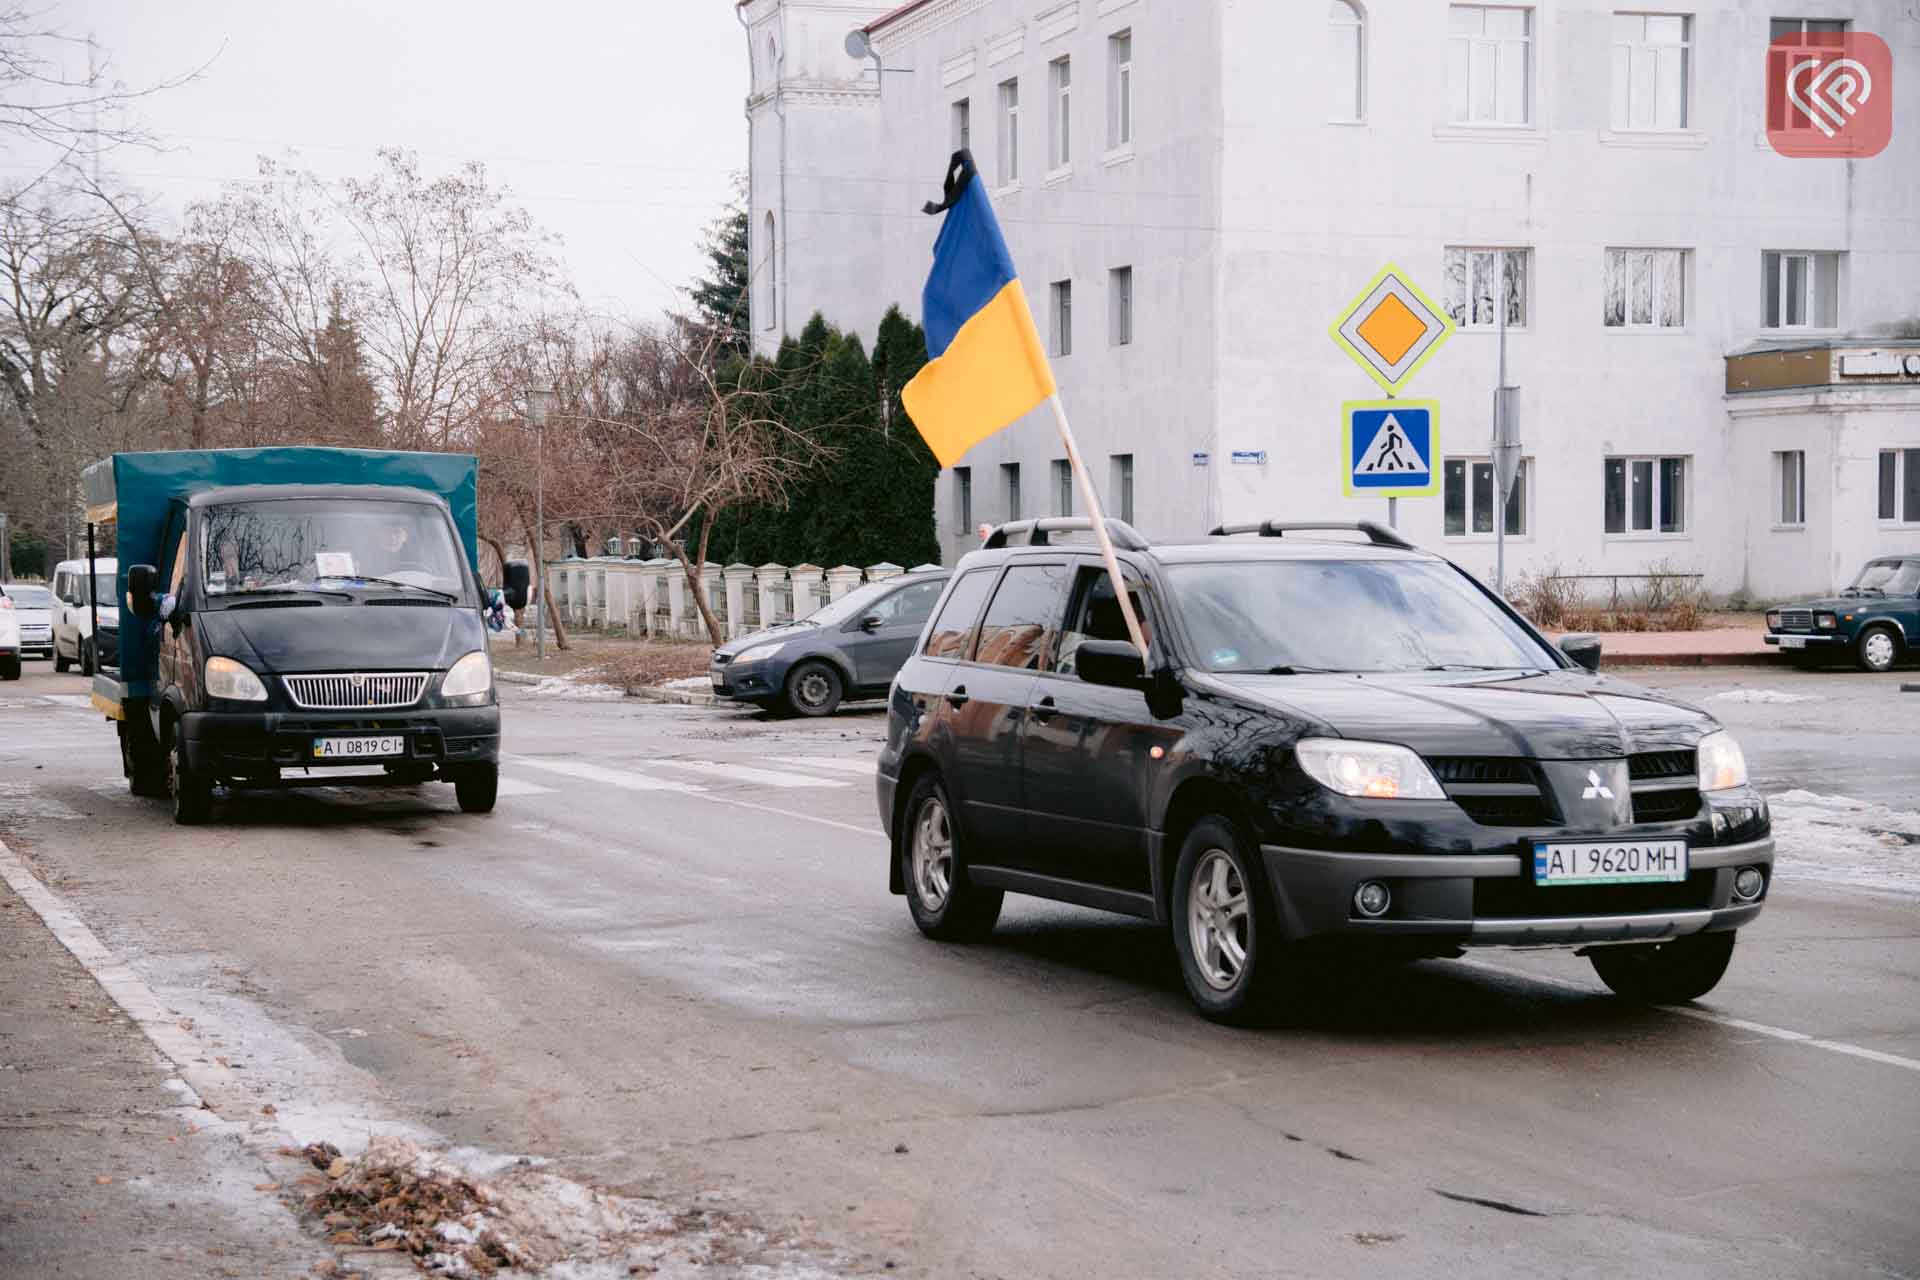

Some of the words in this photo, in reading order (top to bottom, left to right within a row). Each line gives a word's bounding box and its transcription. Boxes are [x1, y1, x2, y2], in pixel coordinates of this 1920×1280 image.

[324, 741, 341, 754] AI
[346, 740, 378, 754] 0819
[380, 739, 397, 753] CI
[1549, 849, 1577, 874] AI
[1588, 847, 1640, 873] 9620
[1646, 846, 1677, 872] MH
